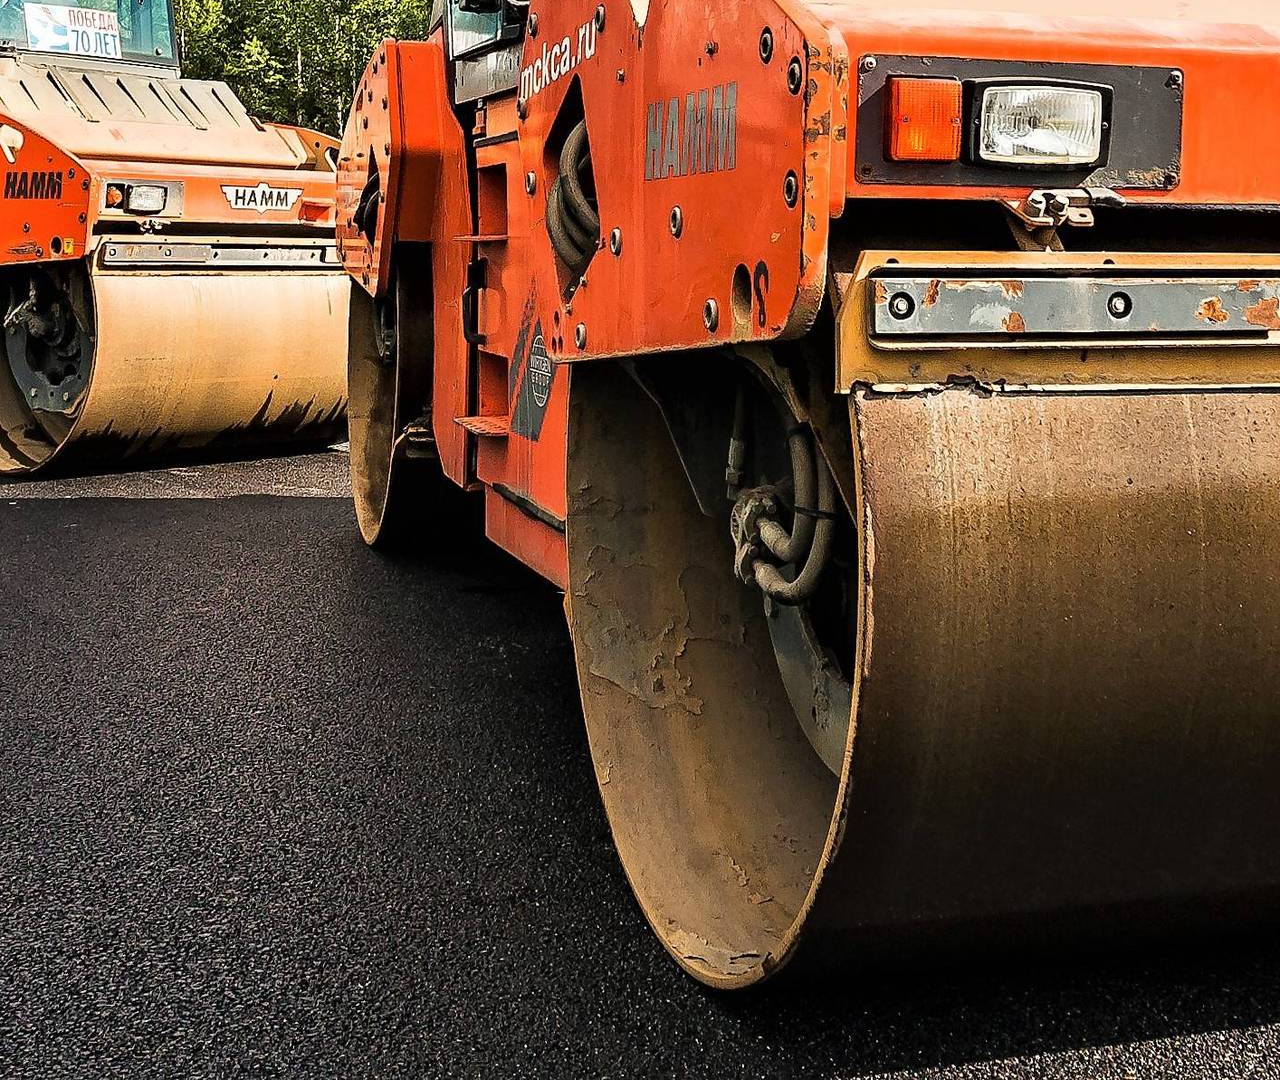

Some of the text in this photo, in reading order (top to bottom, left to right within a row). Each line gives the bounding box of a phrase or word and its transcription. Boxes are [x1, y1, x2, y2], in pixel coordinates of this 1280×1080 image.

[68, 9, 117, 32] ПОБЕДА!
[71, 29, 118, 56] 70 ЛЕТ
[520, 18, 596, 99] mckca.ru
[644, 81, 737, 181] HAMM
[4, 171, 63, 200] HAMM
[234, 189, 289, 207] HAMM
